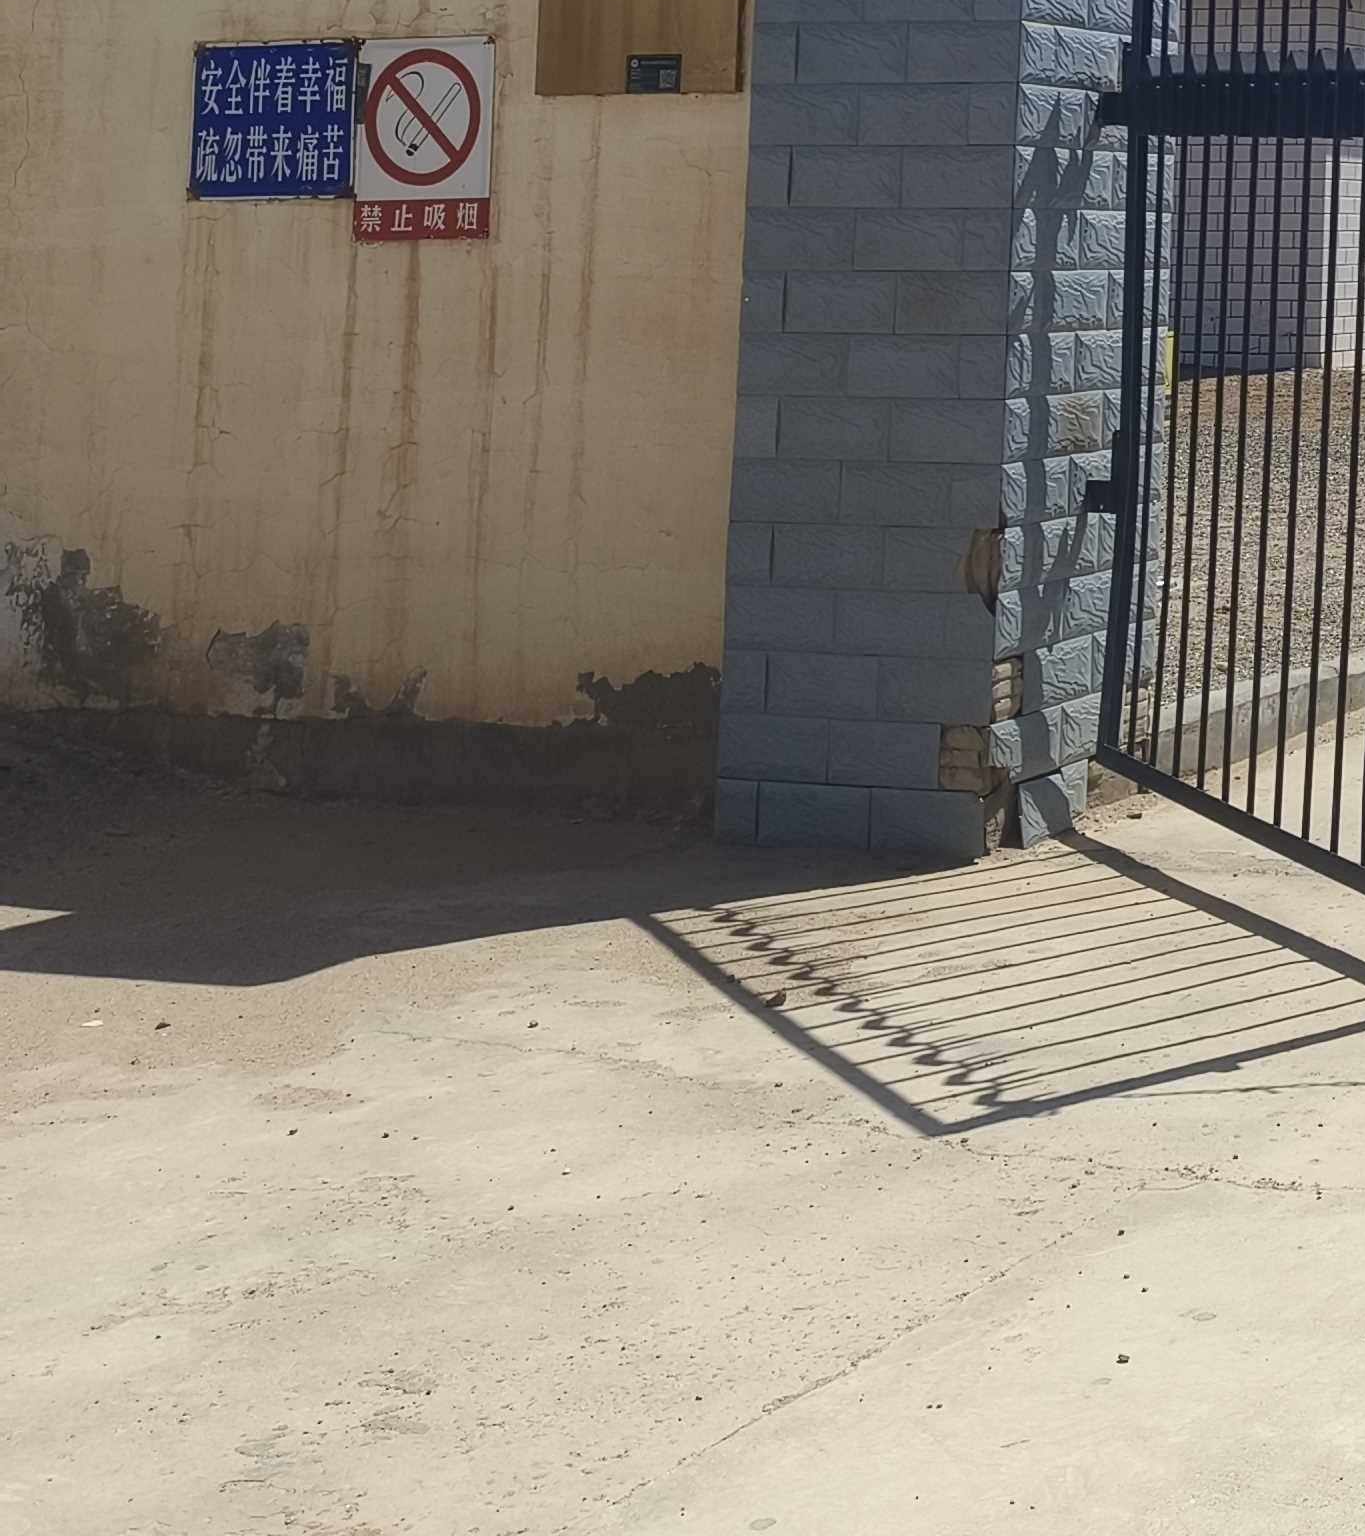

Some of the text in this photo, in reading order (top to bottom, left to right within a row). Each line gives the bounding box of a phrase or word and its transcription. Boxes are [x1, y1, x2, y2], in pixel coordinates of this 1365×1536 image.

[200, 56, 349, 116] 安全伴着幸福
[195, 123, 345, 183] 疏忽带来痛苦
[359, 202, 479, 233] 禁止吸烟
